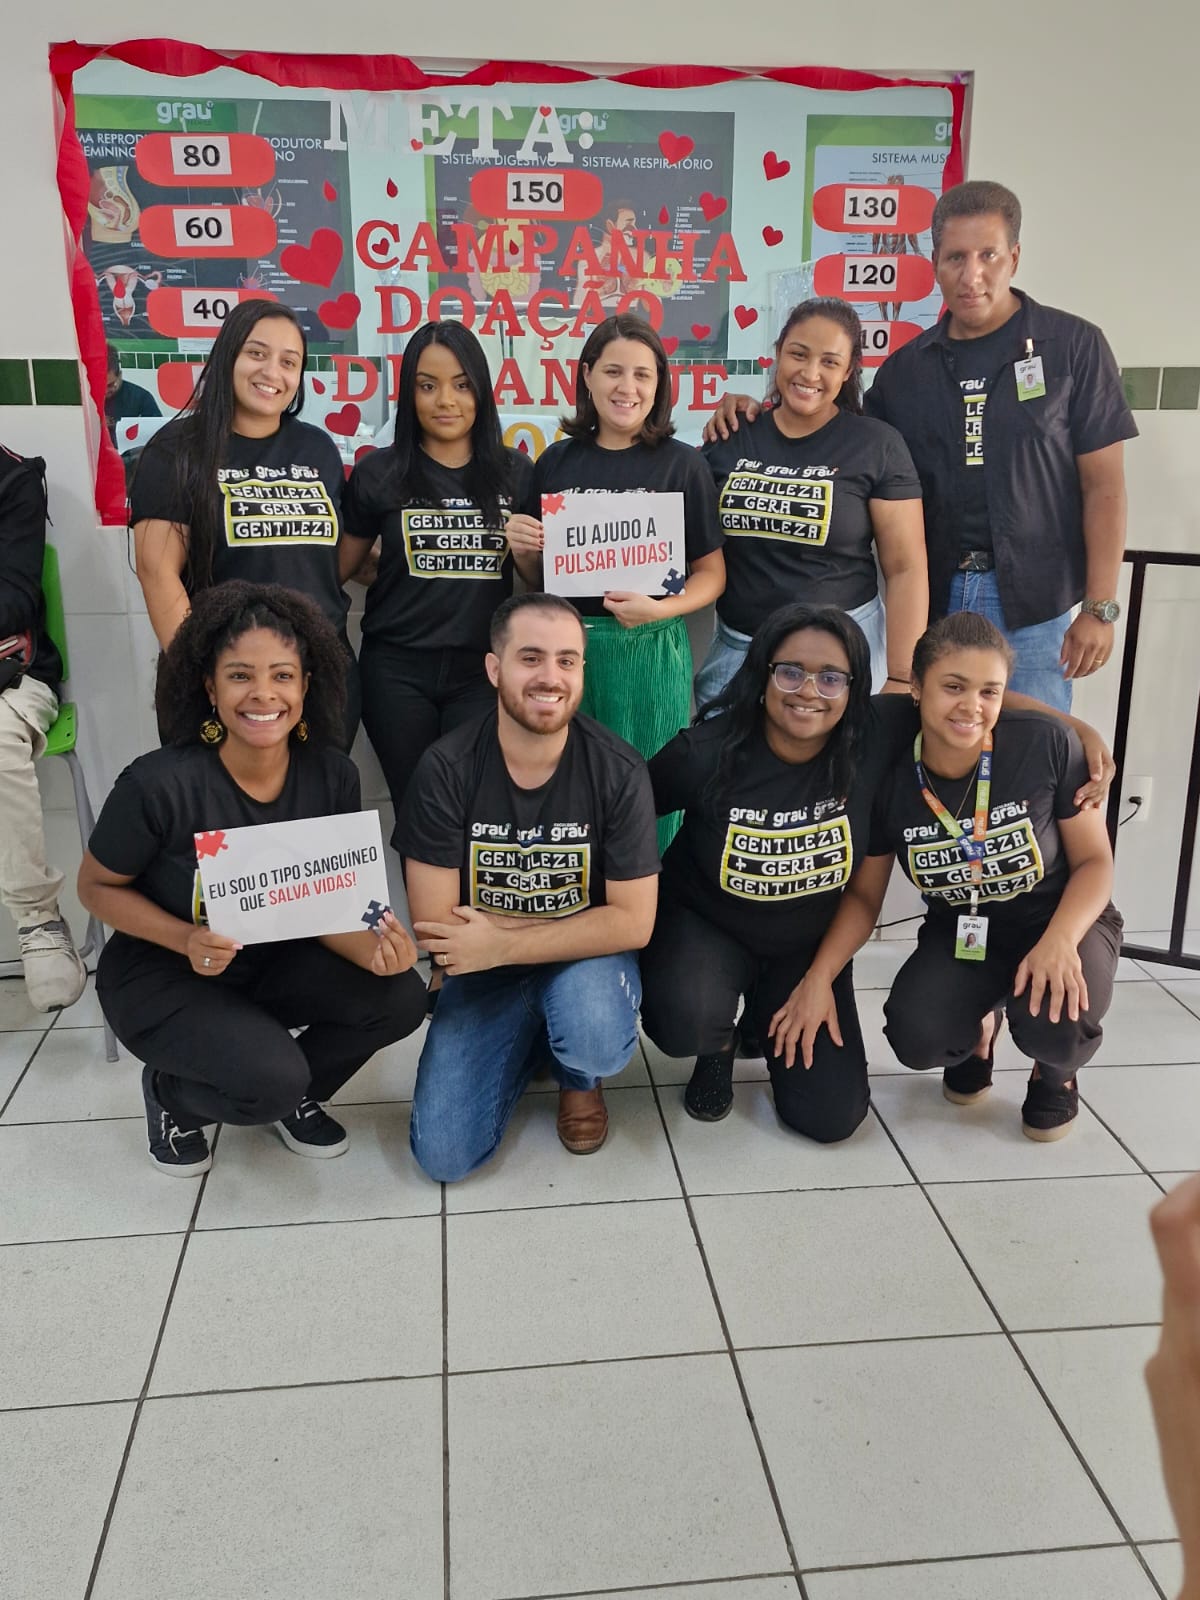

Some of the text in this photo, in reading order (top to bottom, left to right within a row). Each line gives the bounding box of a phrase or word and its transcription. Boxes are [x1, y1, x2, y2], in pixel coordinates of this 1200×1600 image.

[559, 112, 609, 135] gru
[182, 143, 221, 168] 80
[582, 156, 630, 169] SISTEMA
[872, 152, 948, 165] SISTEMA MUS
[511, 180, 563, 203] 150
[848, 195, 897, 218] 130
[185, 216, 222, 239] 60
[356, 219, 748, 283] CAMPANHA
[847, 263, 896, 286] 120
[193, 298, 230, 320] 40
[374, 280, 665, 351] DOAÇÃO
[217, 465, 319, 483] grau grau grau
[764, 465, 800, 476] grau
[802, 467, 839, 478] grau
[230, 485, 322, 499] GENTILEZA
[730, 478, 823, 499] GENTILEZA
[260, 502, 306, 516] GERA
[743, 496, 792, 515] GERA
[235, 521, 333, 538] GENTILEZA
[409, 514, 508, 530] GENTILE
[566, 517, 657, 548] EU AJUDO A
[722, 514, 818, 539] GENTILEZA
[436, 534, 483, 550] GERA
[554, 541, 673, 576] PULSAR VIDAS!
[729, 807, 769, 823] grau
[773, 806, 808, 828] grau
[903, 820, 941, 842] grau
[990, 800, 1029, 825] grau
[471, 822, 512, 838] grau
[550, 822, 591, 841] grau
[734, 827, 842, 855] GENTILEZA
[479, 850, 580, 870] GENTILEZA
[915, 830, 1026, 868] GENTEZA
[209, 846, 378, 899] EU SOU O TIPO SANGUÍNEO
[761, 855, 815, 876] GERA
[946, 861, 1003, 885] GEA
[240, 871, 357, 912] QUE SALVA VIDAS!
[506, 872, 552, 892] GERA
[728, 868, 844, 896] GENTILEZA
[929, 871, 1037, 901] ENTILEZA
[480, 887, 581, 912] GENTILEZA
